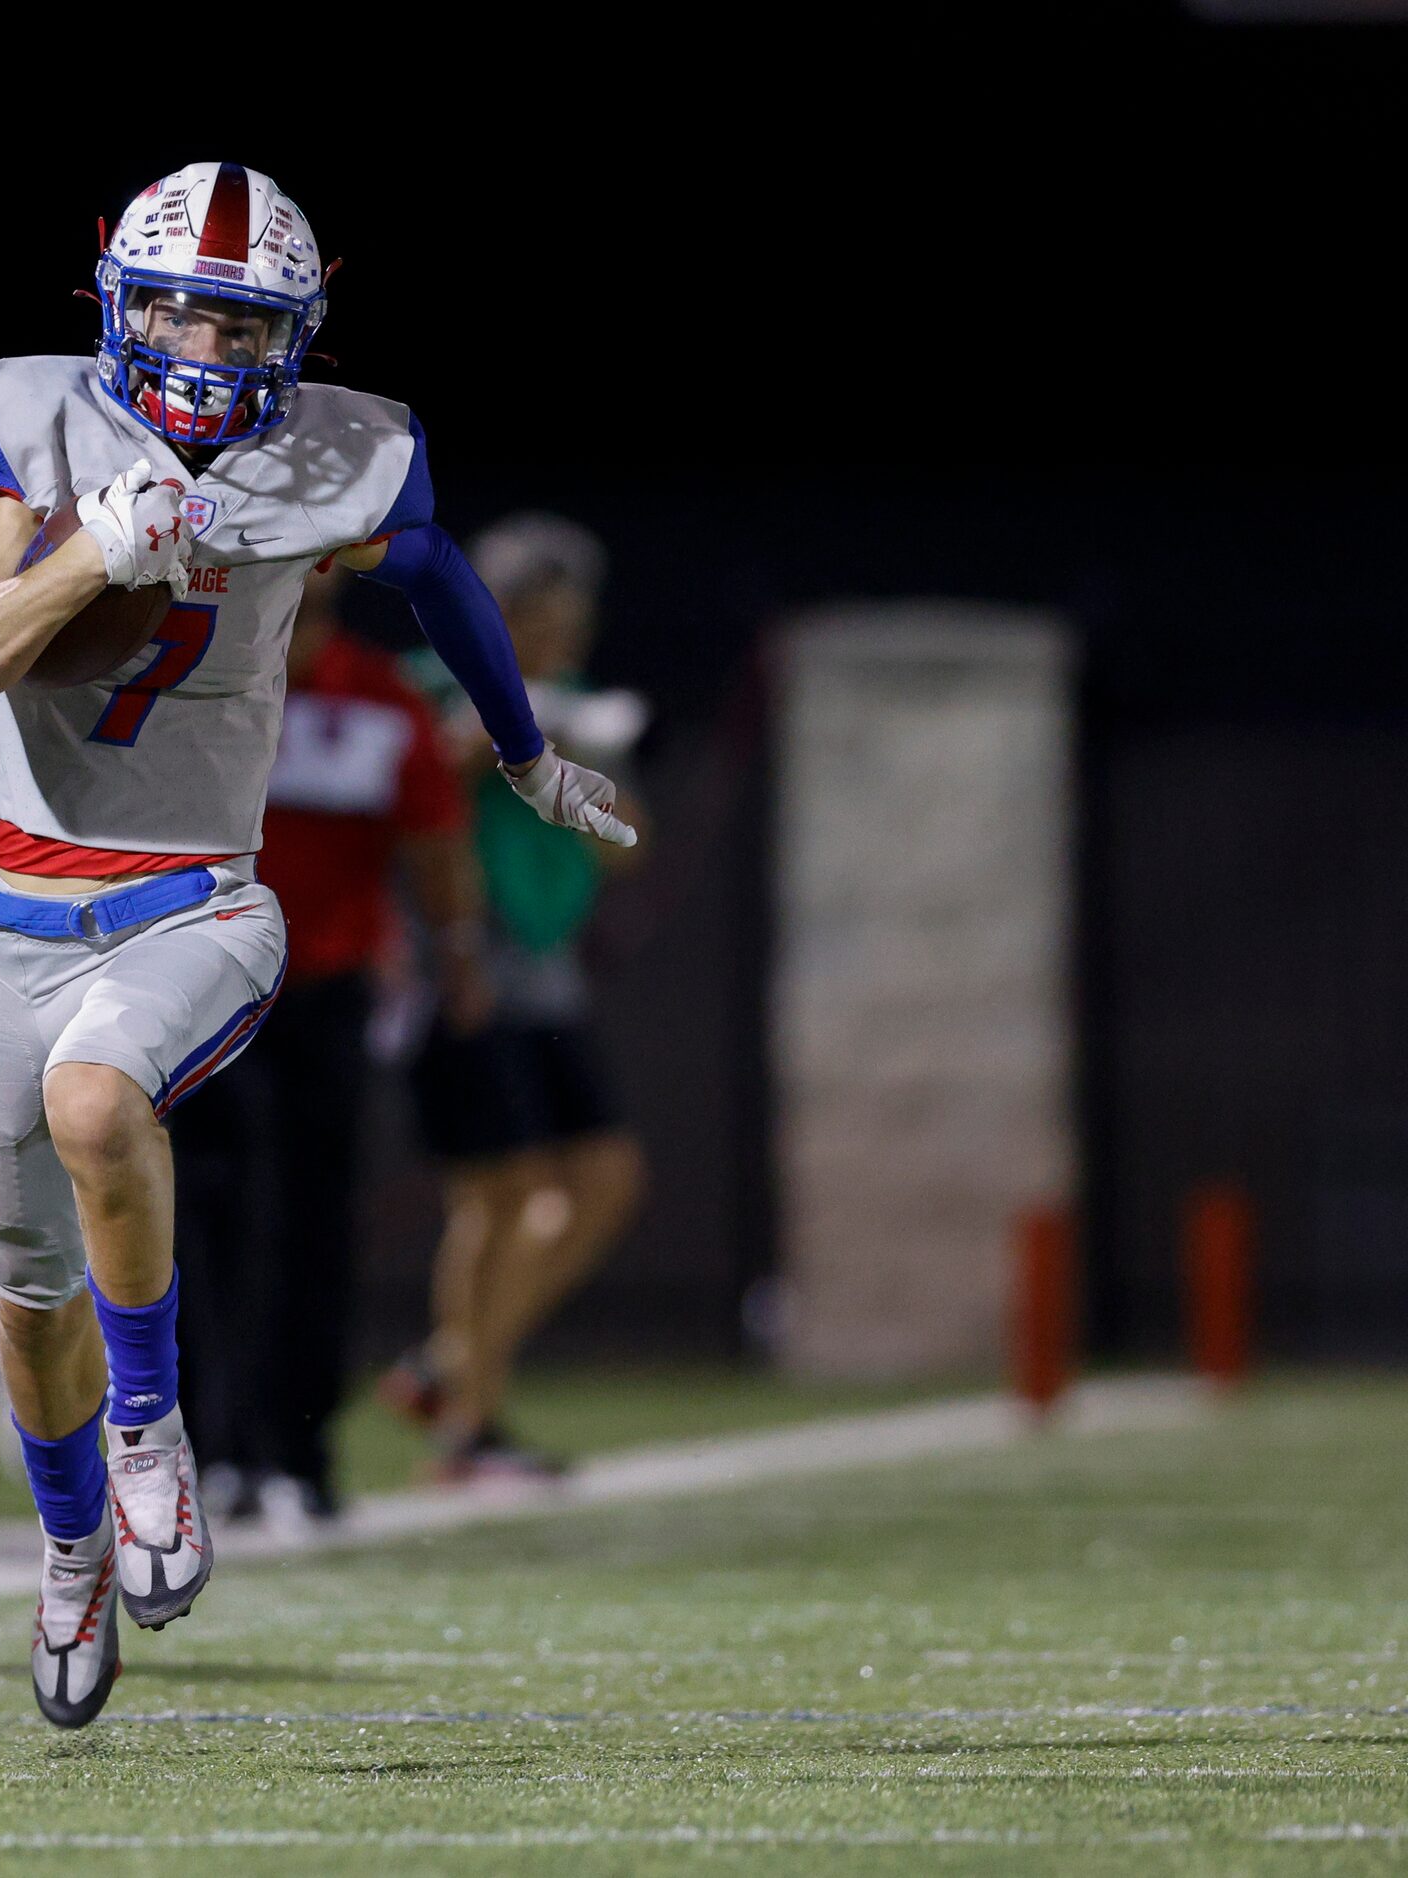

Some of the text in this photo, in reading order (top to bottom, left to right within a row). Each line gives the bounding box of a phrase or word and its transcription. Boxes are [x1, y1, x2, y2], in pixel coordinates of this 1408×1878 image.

[164, 189, 187, 199] FIGHT
[161, 199, 183, 210] FIGHT
[162, 212, 185, 223] FIGHT
[165, 227, 189, 237] FIGHT
[264, 240, 283, 255] FIGHT
[193, 260, 245, 281] JAGUARS
[175, 420, 206, 432] Ridell
[88, 604, 219, 747] 7
